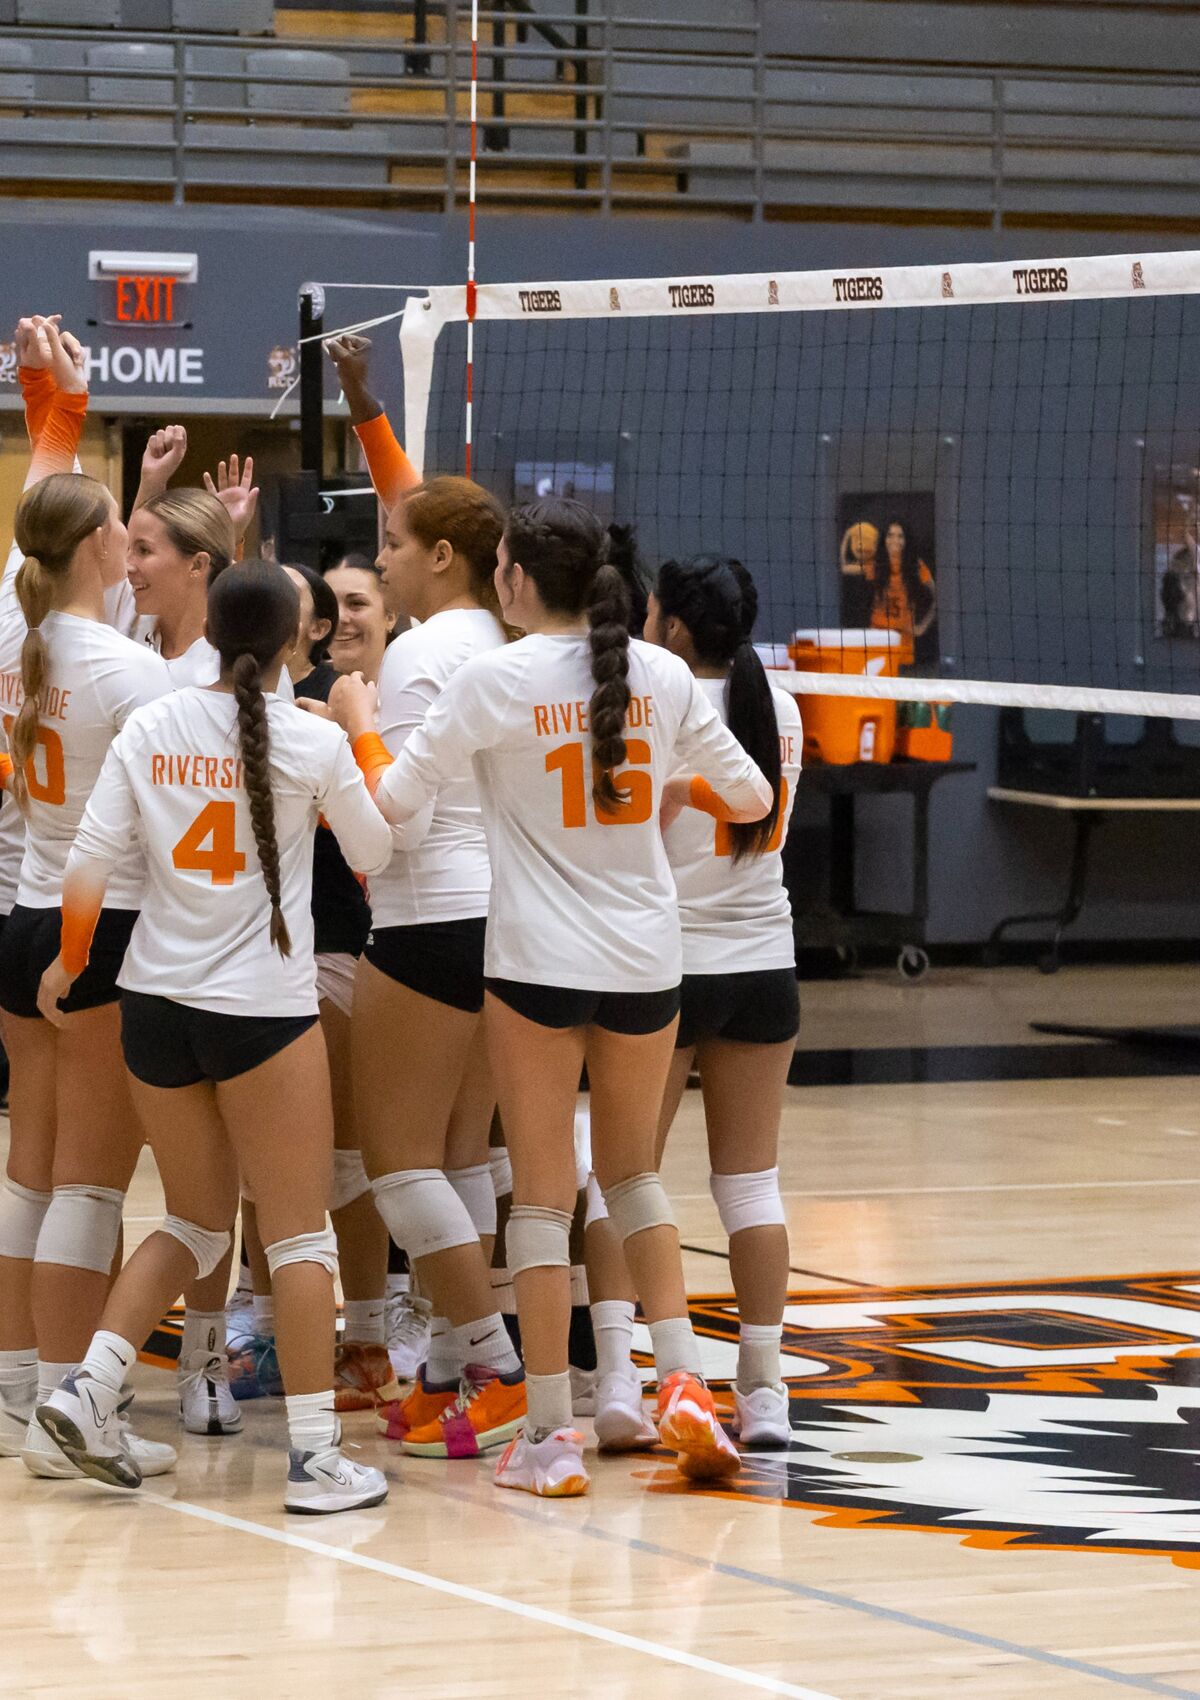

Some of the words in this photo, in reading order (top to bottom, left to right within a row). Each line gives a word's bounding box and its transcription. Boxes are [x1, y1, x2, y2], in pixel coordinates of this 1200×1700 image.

[116, 276, 177, 322] EXIT
[518, 290, 562, 312] TIGERS
[668, 284, 715, 308] TIGERS
[833, 276, 883, 302] TIGERS
[1013, 267, 1068, 294] TIGERS
[84, 346, 204, 384] HOME
[533, 696, 653, 736] RIVEDE
[152, 754, 242, 789] RIVERSI
[545, 738, 653, 829] 16
[172, 800, 246, 885] 4
